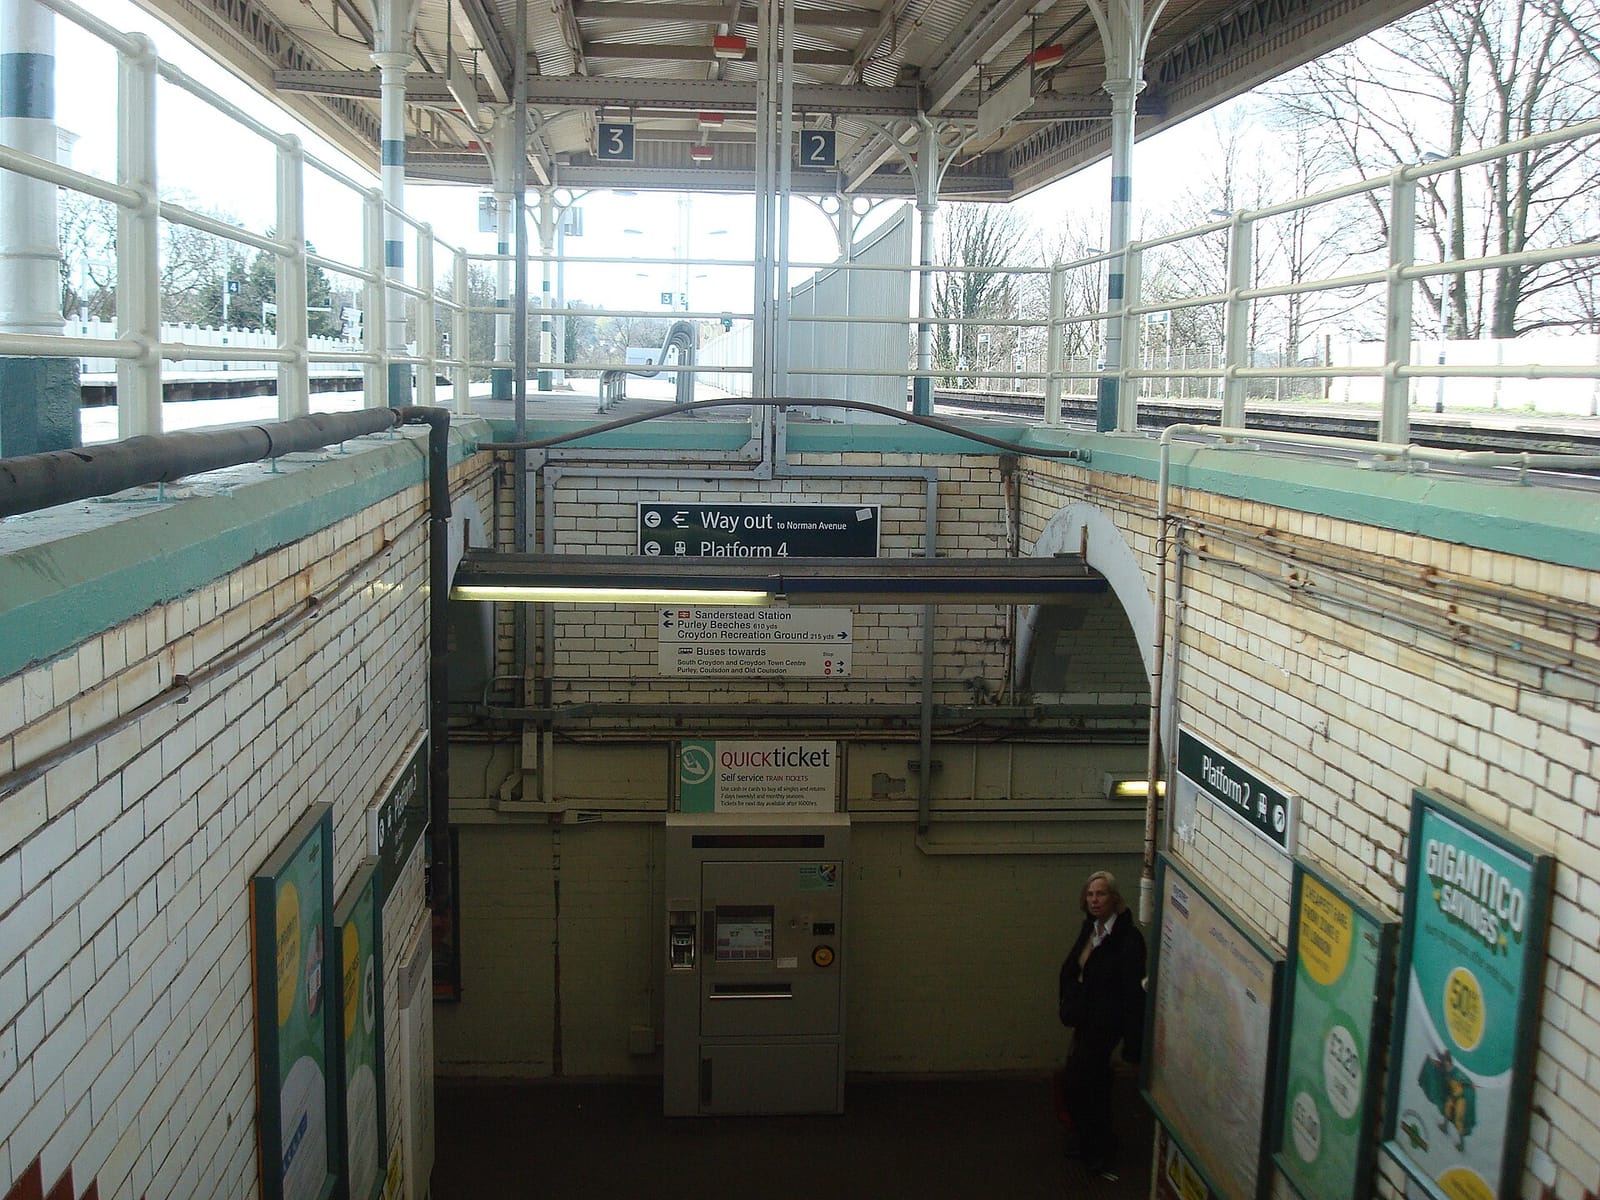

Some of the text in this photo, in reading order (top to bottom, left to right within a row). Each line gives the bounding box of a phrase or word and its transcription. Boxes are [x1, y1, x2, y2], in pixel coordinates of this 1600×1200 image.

[608, 128, 623, 154] 3
[810, 135, 826, 161] 2
[229, 283, 238, 292] 4
[700, 511, 847, 533] Way out to Norman Avenue
[701, 541, 789, 557] Platform 4
[695, 610, 792, 620] Sanderstead Station
[677, 621, 707, 631] Purley
[710, 621, 751, 630] Beeches
[677, 630, 718, 640] Croydon
[720, 630, 773, 640] Recreation
[774, 631, 808, 640] Ground
[696, 647, 767, 656] Buses towards
[697, 659, 724, 667] Croydon
[739, 659, 766, 667] Croydon
[721, 773, 736, 782] Self
[737, 774, 764, 782] service
[1201, 754, 1250, 811] Platform 2
[1426, 838, 1525, 933] GIGANTICO
[1440, 884, 1499, 945] SAVINGS
